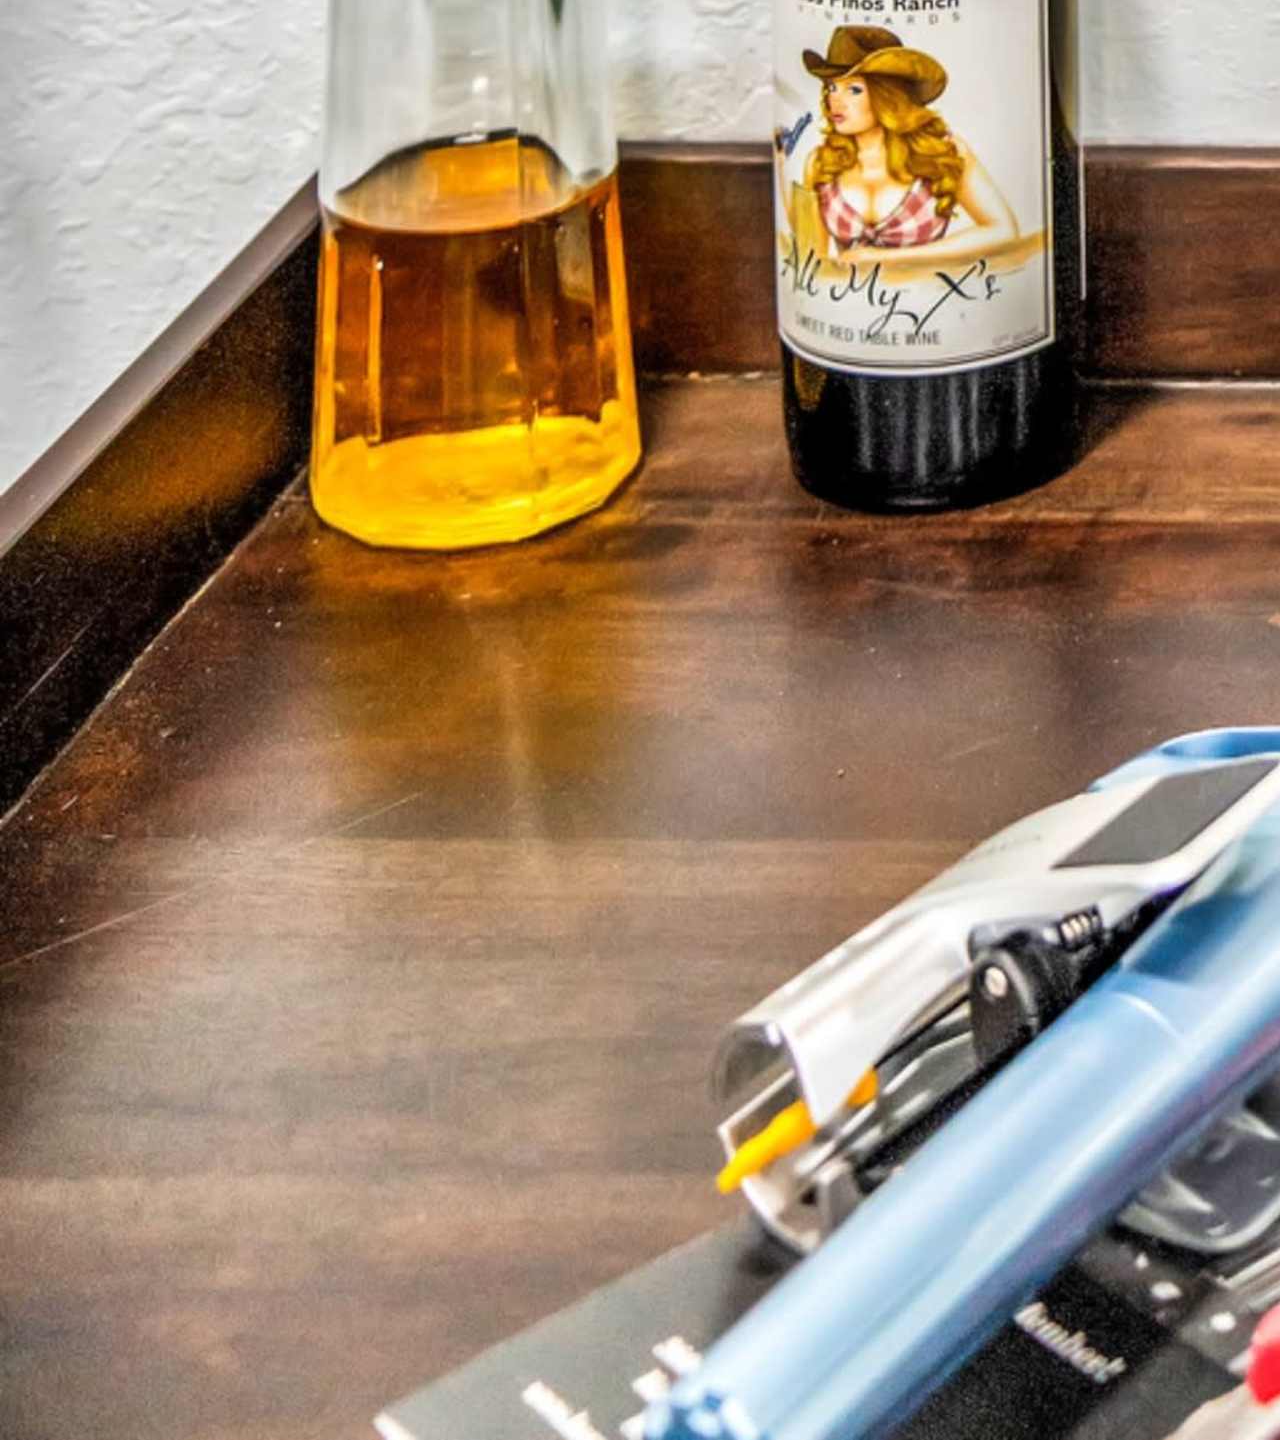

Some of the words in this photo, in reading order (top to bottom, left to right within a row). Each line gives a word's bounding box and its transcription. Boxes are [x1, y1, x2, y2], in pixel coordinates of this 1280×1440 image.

[782, 236, 819, 297] All
[829, 262, 919, 340] My
[829, 324, 854, 343] RED
[905, 329, 941, 346] WINE
